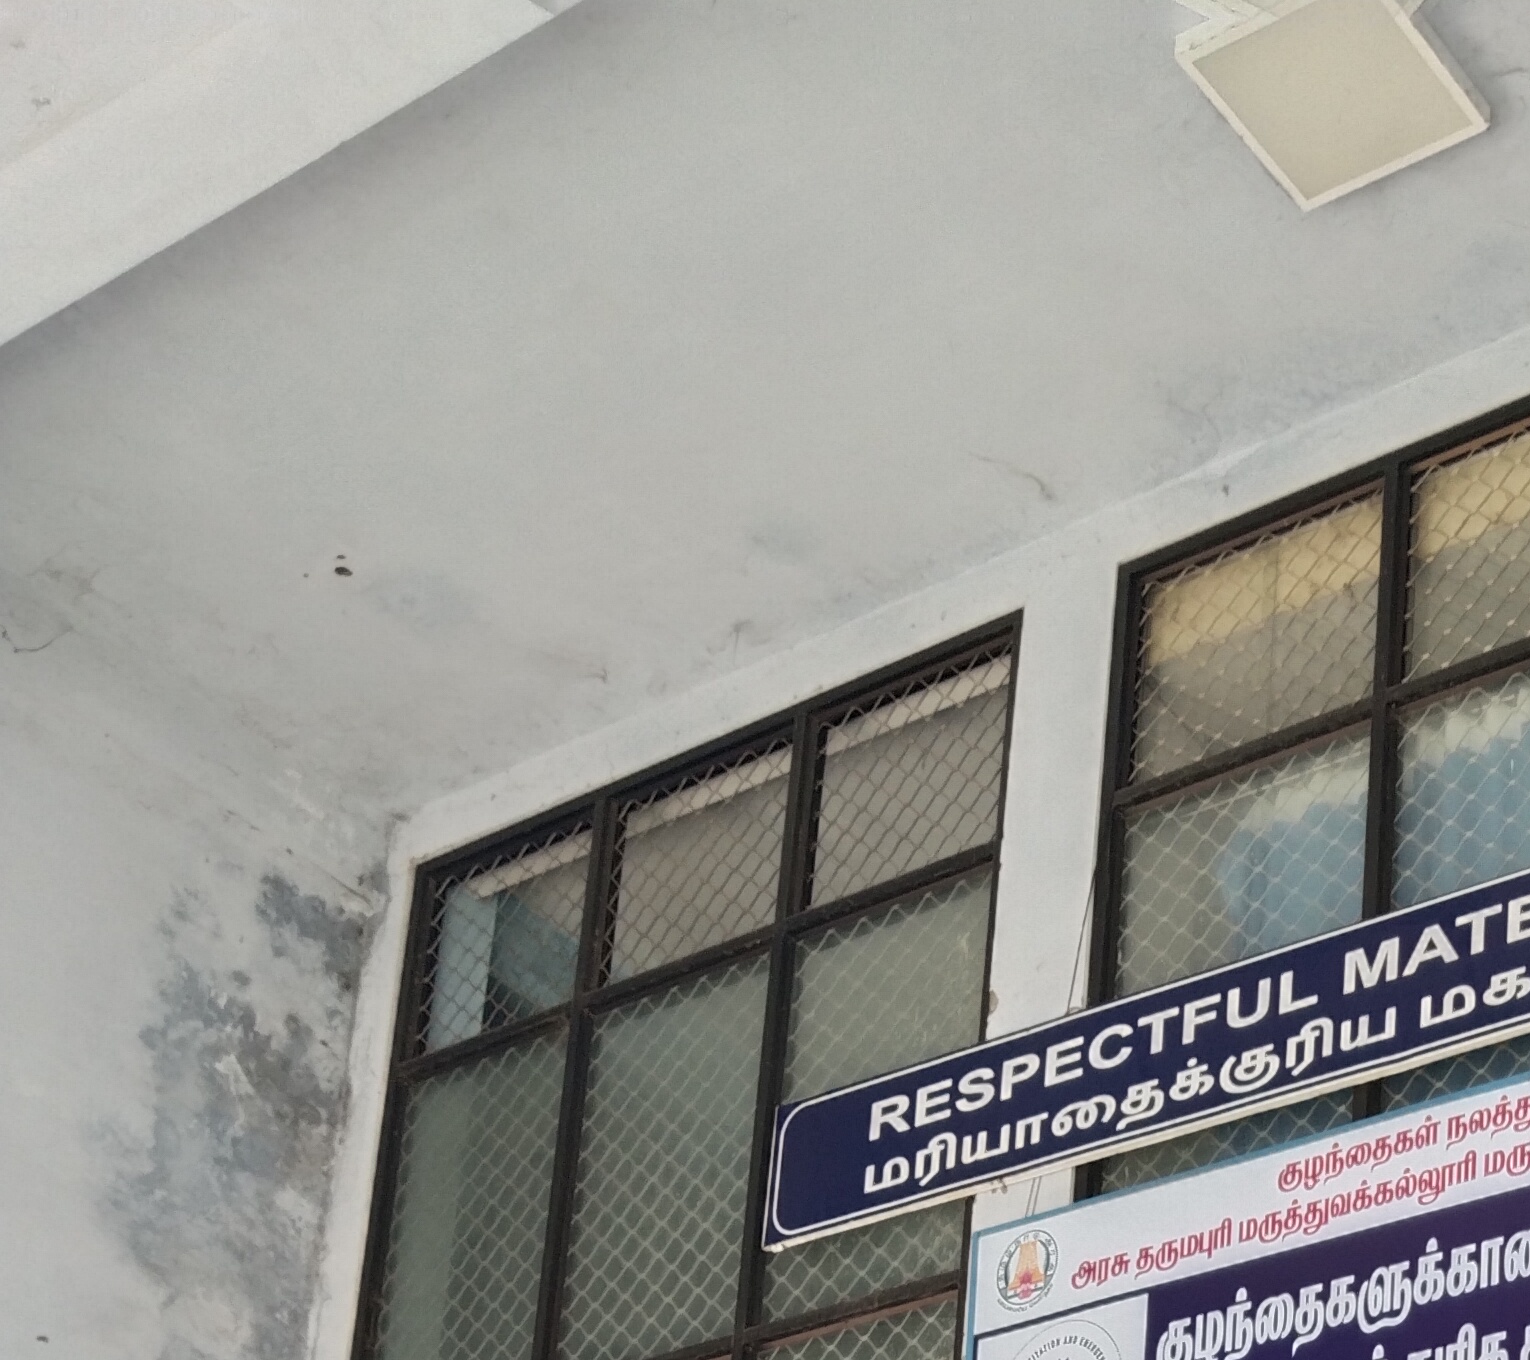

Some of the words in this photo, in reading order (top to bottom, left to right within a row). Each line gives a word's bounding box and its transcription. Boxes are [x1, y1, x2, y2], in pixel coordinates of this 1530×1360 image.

[863, 1006, 1396, 1193] மரியாதைக்குரிய
[868, 970, 1318, 1141] RESPECTFUL
[1071, 1252, 1130, 1289] அரசு
[1134, 1217, 1231, 1277] தருமபுரி
[1238, 1156, 1476, 1242] மருத்துவக்கல்லூரி
[1278, 1115, 1440, 1192] குழந்தைகள்
